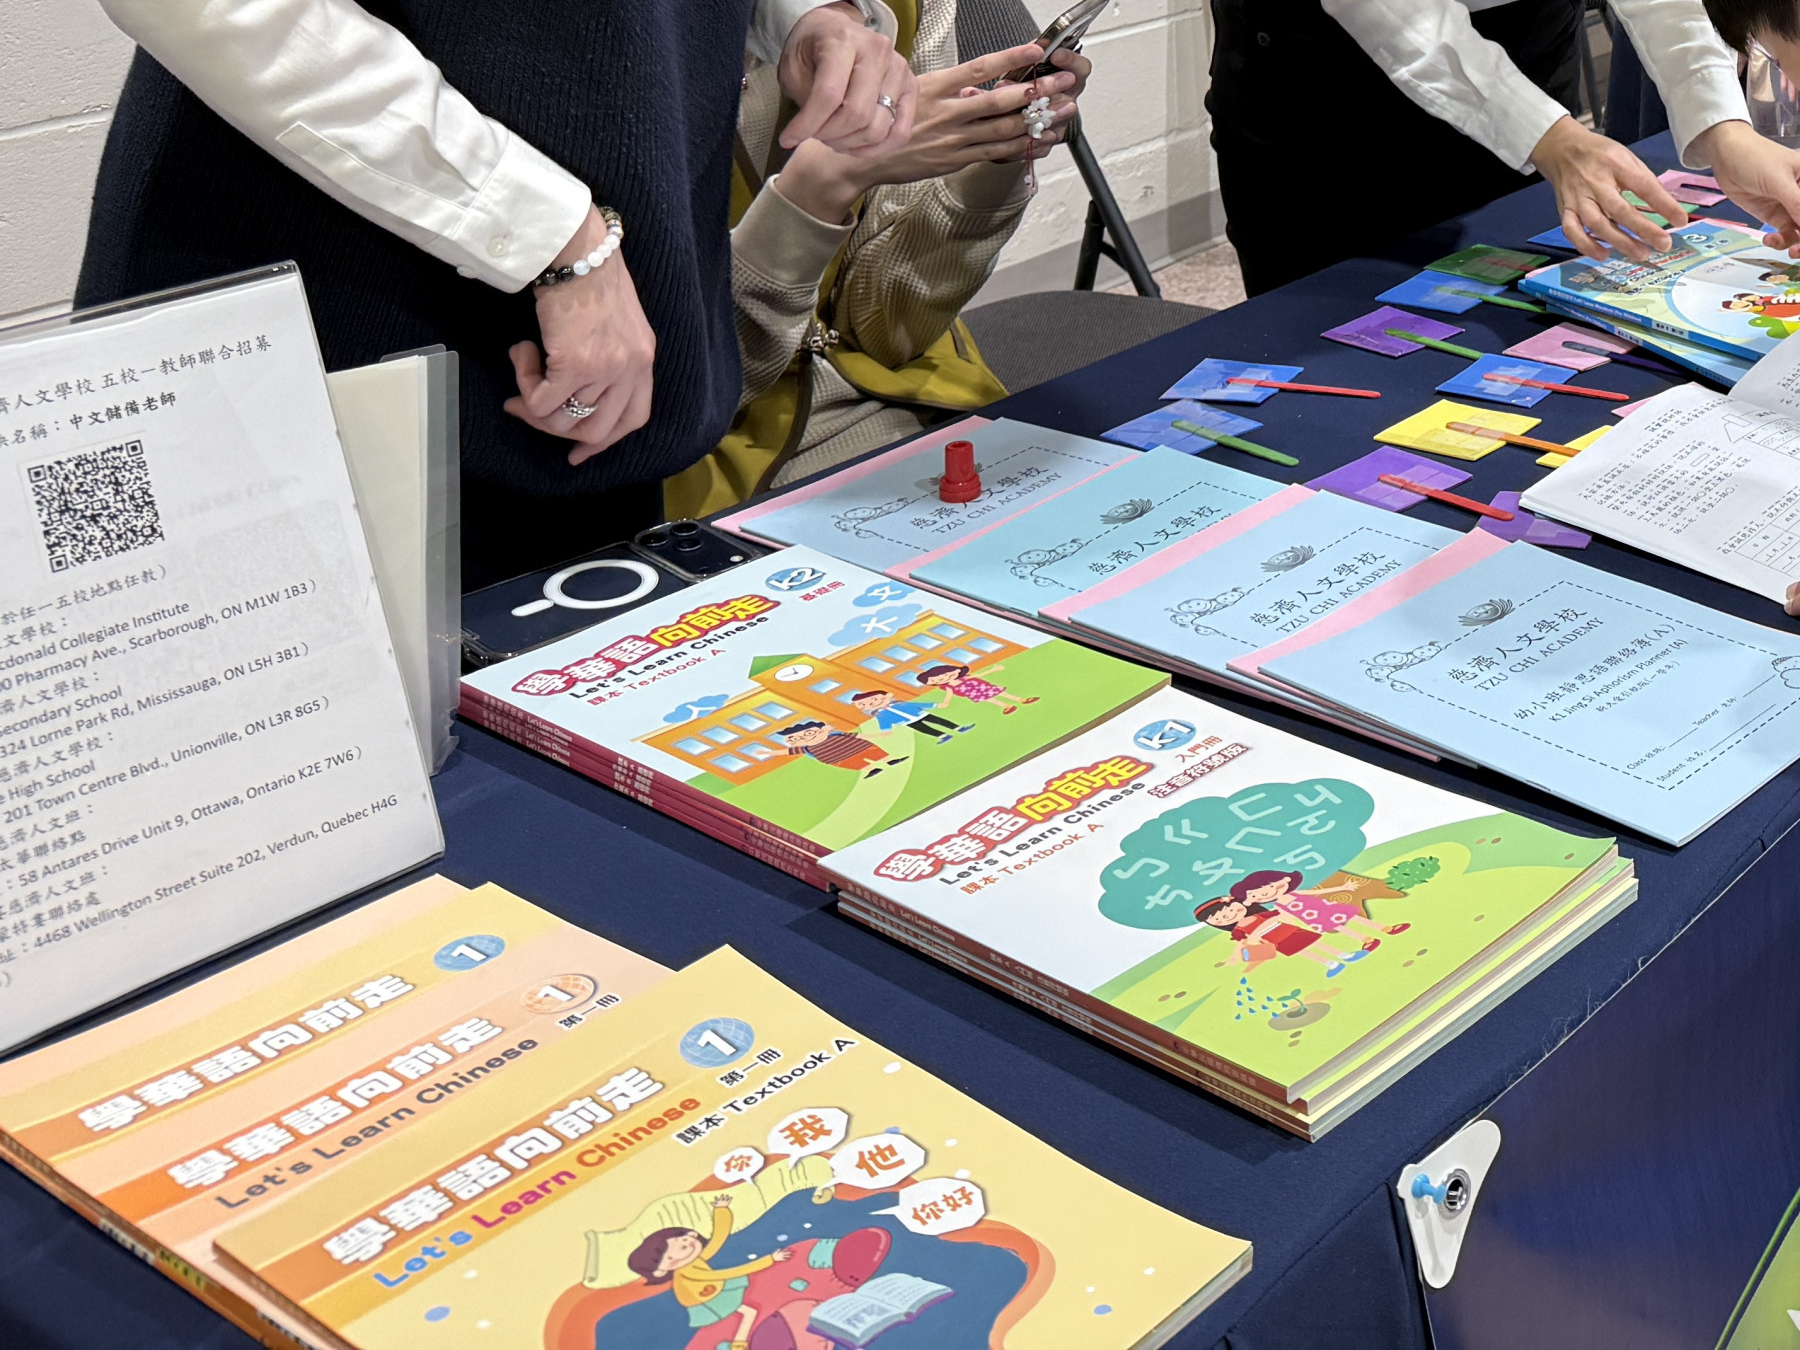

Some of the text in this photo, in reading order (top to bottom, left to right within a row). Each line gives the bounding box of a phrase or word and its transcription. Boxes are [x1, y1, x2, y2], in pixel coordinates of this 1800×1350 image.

[931, 472, 1063, 535] TZU CHI ACADEMY
[1087, 504, 1223, 577] 慈濟人文學校
[1248, 548, 1387, 627] 慈濟人文學校
[1275, 558, 1402, 634] TZU CHI ACADEMY
[16, 656, 88, 687] Pharmacy
[129, 613, 219, 651] Scarborough,
[221, 603, 243, 620] ON
[245, 592, 280, 612] M1W
[60, 603, 190, 652] Collegiate Institute
[516, 594, 773, 695] 學華語向前走
[569, 616, 769, 699] Let's Learn Chinese
[1446, 605, 1588, 686] 慈濟人文學校
[1474, 616, 1606, 693] TZU CHI ACADEMY
[29, 655, 273, 748] Lorne Park Rd, Mississauga, ON L5H
[74, 685, 123, 712] School
[586, 648, 726, 707] 課本 Textbook A
[1593, 668, 1638, 701] Aphorism
[1636, 647, 1673, 677] Planner
[3, 803, 33, 824] 201
[36, 790, 76, 812] Town
[78, 772, 127, 796] Centre
[170, 730, 243, 763] Unionville,
[245, 719, 266, 737] ON
[268, 710, 293, 729] L3R
[8, 779, 43, 800] High
[46, 760, 95, 788] School
[1149, 743, 1248, 798] 注音符號版
[1175, 735, 1222, 763] 入門冊
[42, 849, 99, 878] Antares
[101, 834, 140, 856] Drive
[142, 820, 173, 840] Unit
[174, 814, 189, 828] 9,
[191, 795, 244, 822] Ottawa,
[246, 773, 296, 799] Ontario
[298, 761, 324, 780] K2E
[883, 755, 1151, 881] 學華語向前走
[939, 781, 1146, 886] Let's Learn Chinese
[34, 793, 398, 949] 4468 Wellington Street Suite 202, Verdun, Quebec H4G
[960, 822, 1105, 896] 課本 Textbook A
[556, 991, 622, 1030] 第一冊
[77, 972, 417, 1134] 學華語向前走
[673, 1034, 858, 1146] 課本 Textbook A
[718, 1046, 784, 1089] 第一冊
[166, 1016, 503, 1191] 學華語向前走
[216, 1034, 540, 1211] Let's Learn Chinese
[777, 1113, 834, 1150] 我
[321, 1066, 666, 1266] 學華語向前走
[373, 1094, 702, 1290] Let's Learn Chinese
[722, 1152, 753, 1175] 你
[853, 1142, 906, 1179] 他
[909, 1185, 977, 1228] 你好
